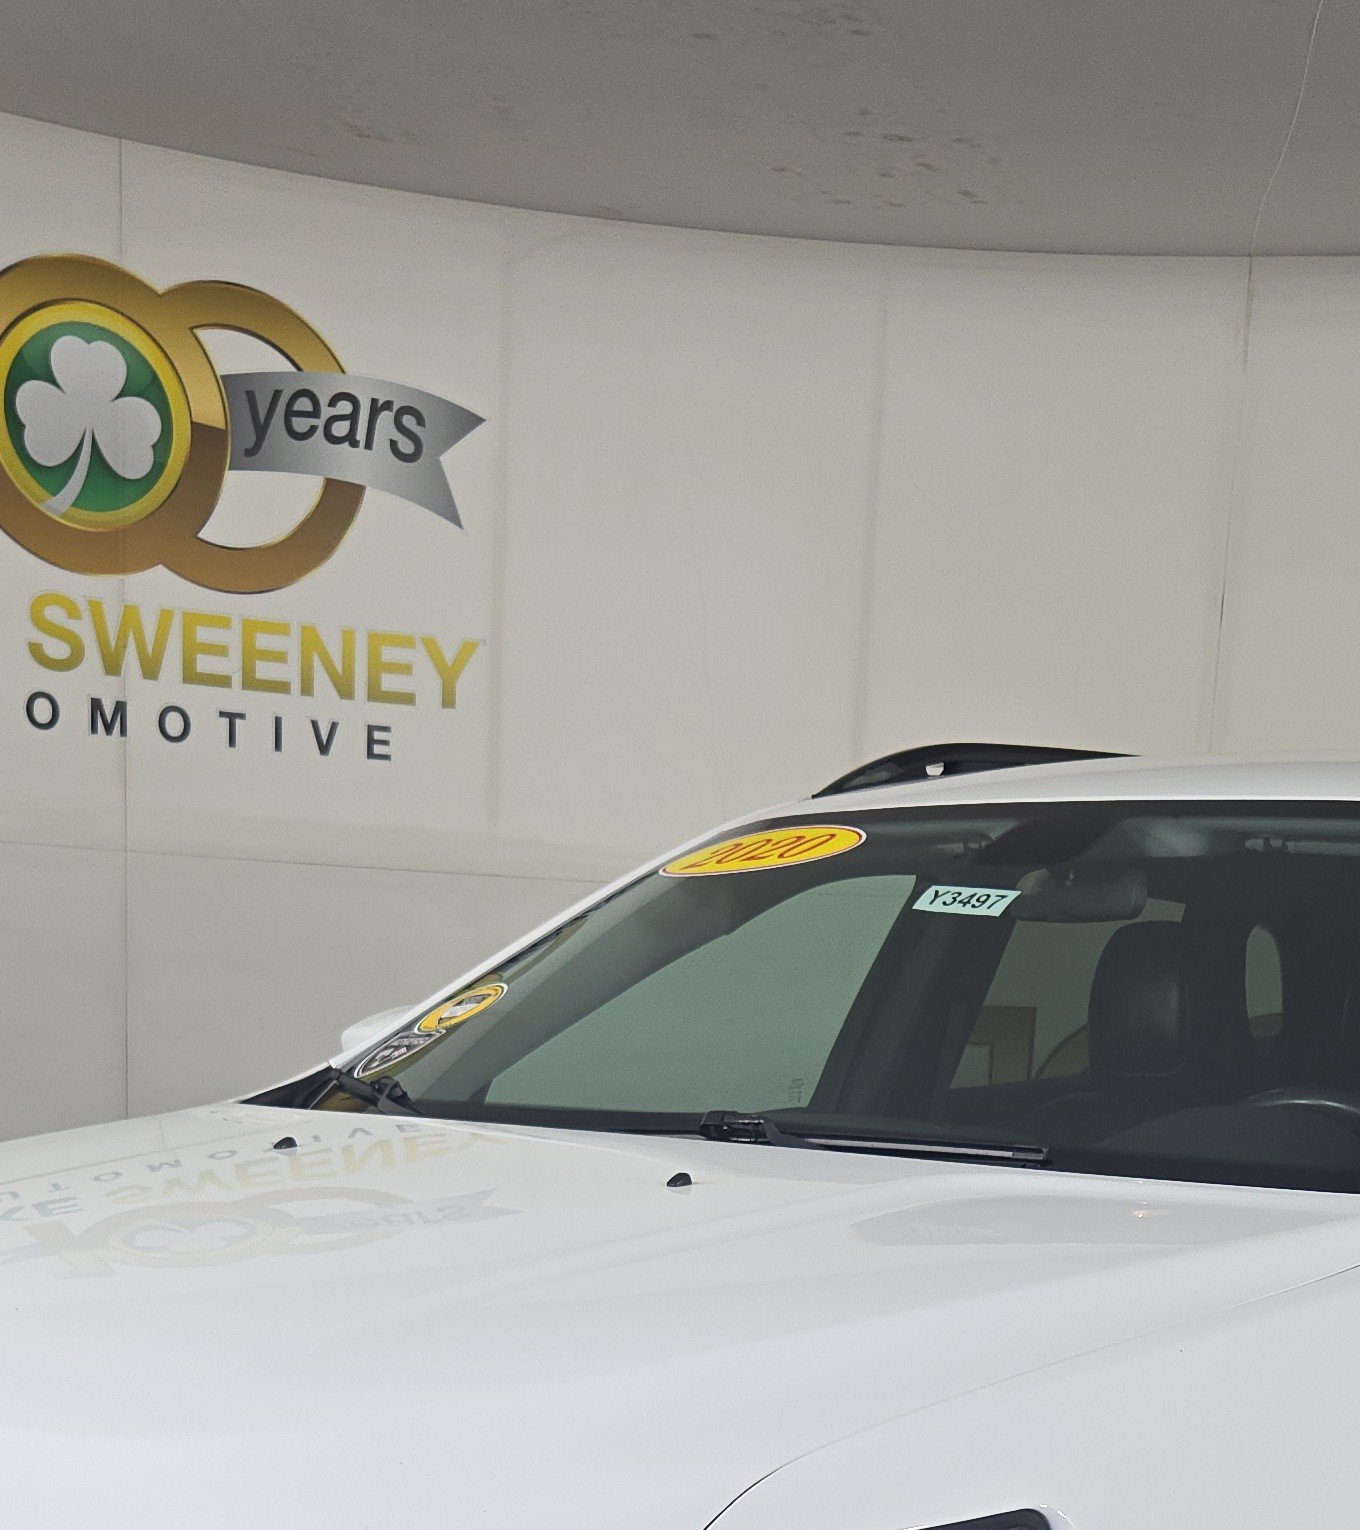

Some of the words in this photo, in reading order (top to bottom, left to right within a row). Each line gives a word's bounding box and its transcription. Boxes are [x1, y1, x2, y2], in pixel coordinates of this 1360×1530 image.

[242, 386, 426, 464] years
[27, 593, 482, 711] SWEENEY
[680, 832, 839, 870] 2020
[927, 889, 1006, 910] Y3497
